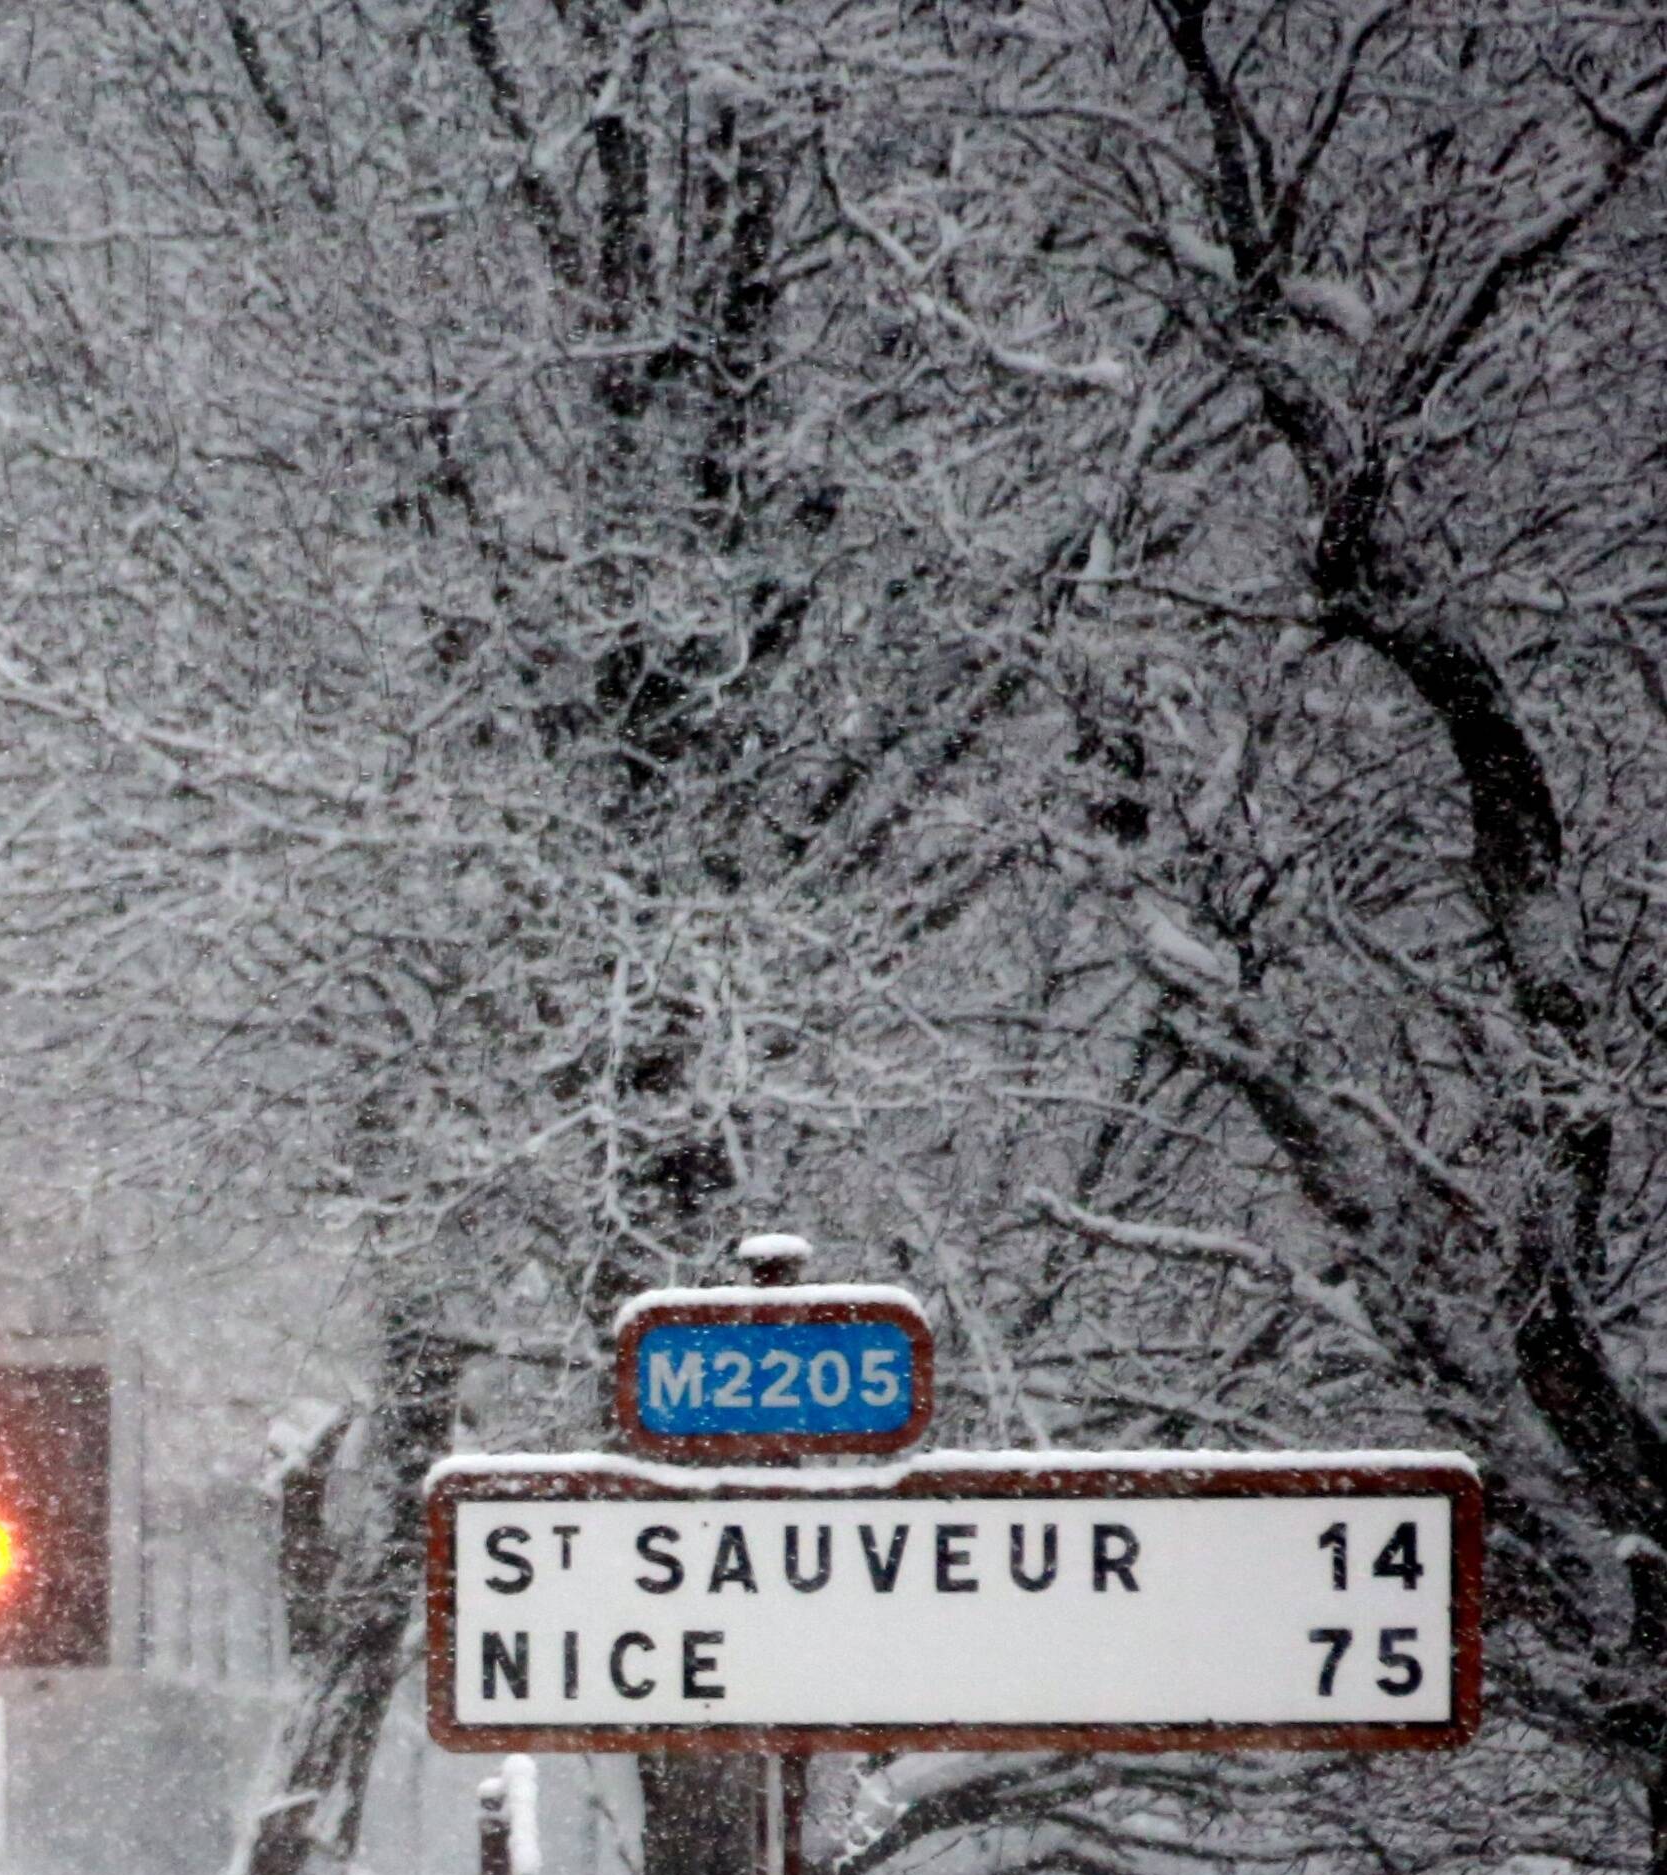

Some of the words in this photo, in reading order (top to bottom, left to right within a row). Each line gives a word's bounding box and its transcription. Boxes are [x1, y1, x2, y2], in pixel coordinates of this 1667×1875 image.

[649, 1350, 898, 1407] M2205
[636, 1525, 1140, 1594] SAUVEUR
[1318, 1521, 1424, 1591] 14
[482, 1630, 726, 1699] NICE
[1309, 1628, 1424, 1697] 75
